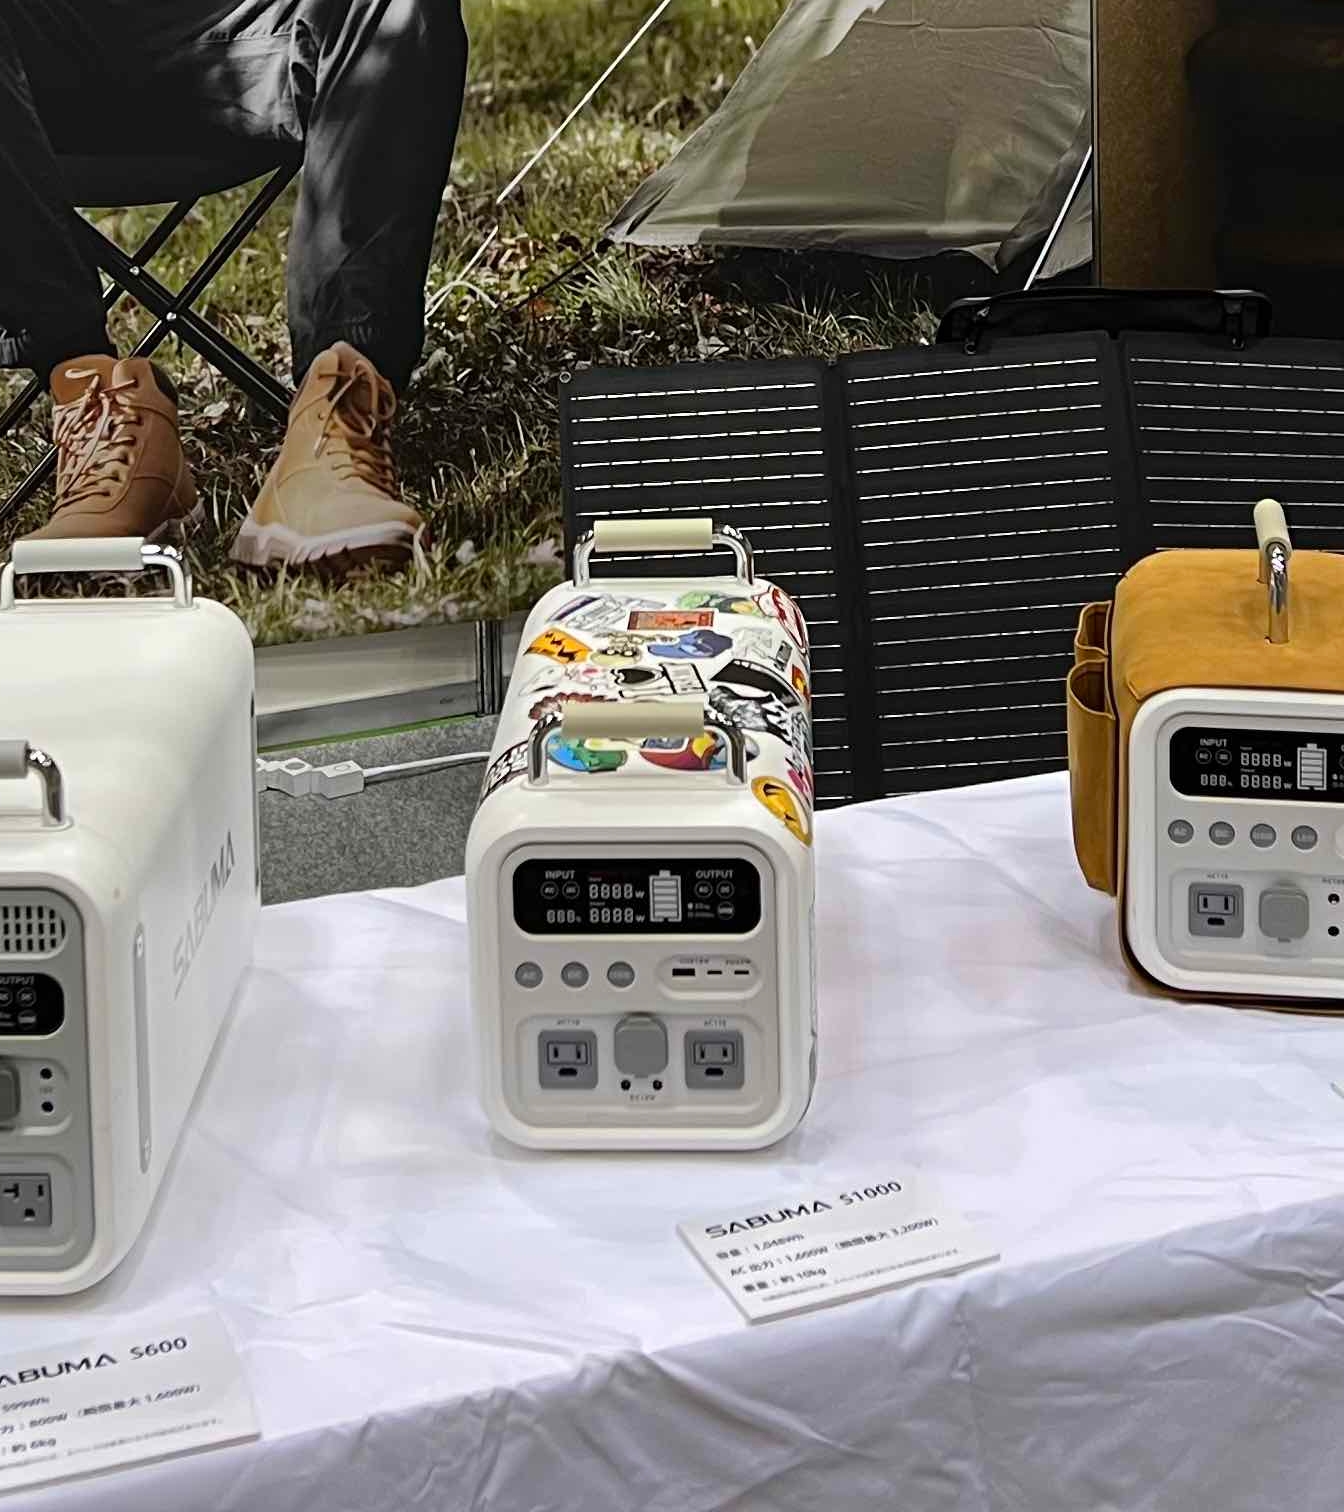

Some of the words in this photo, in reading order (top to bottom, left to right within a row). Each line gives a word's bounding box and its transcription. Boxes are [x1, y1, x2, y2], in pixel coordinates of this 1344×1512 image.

[705, 1201, 832, 1238] SABUMA
[839, 1181, 903, 1206] S1000
[129, 1337, 188, 1361] S600
